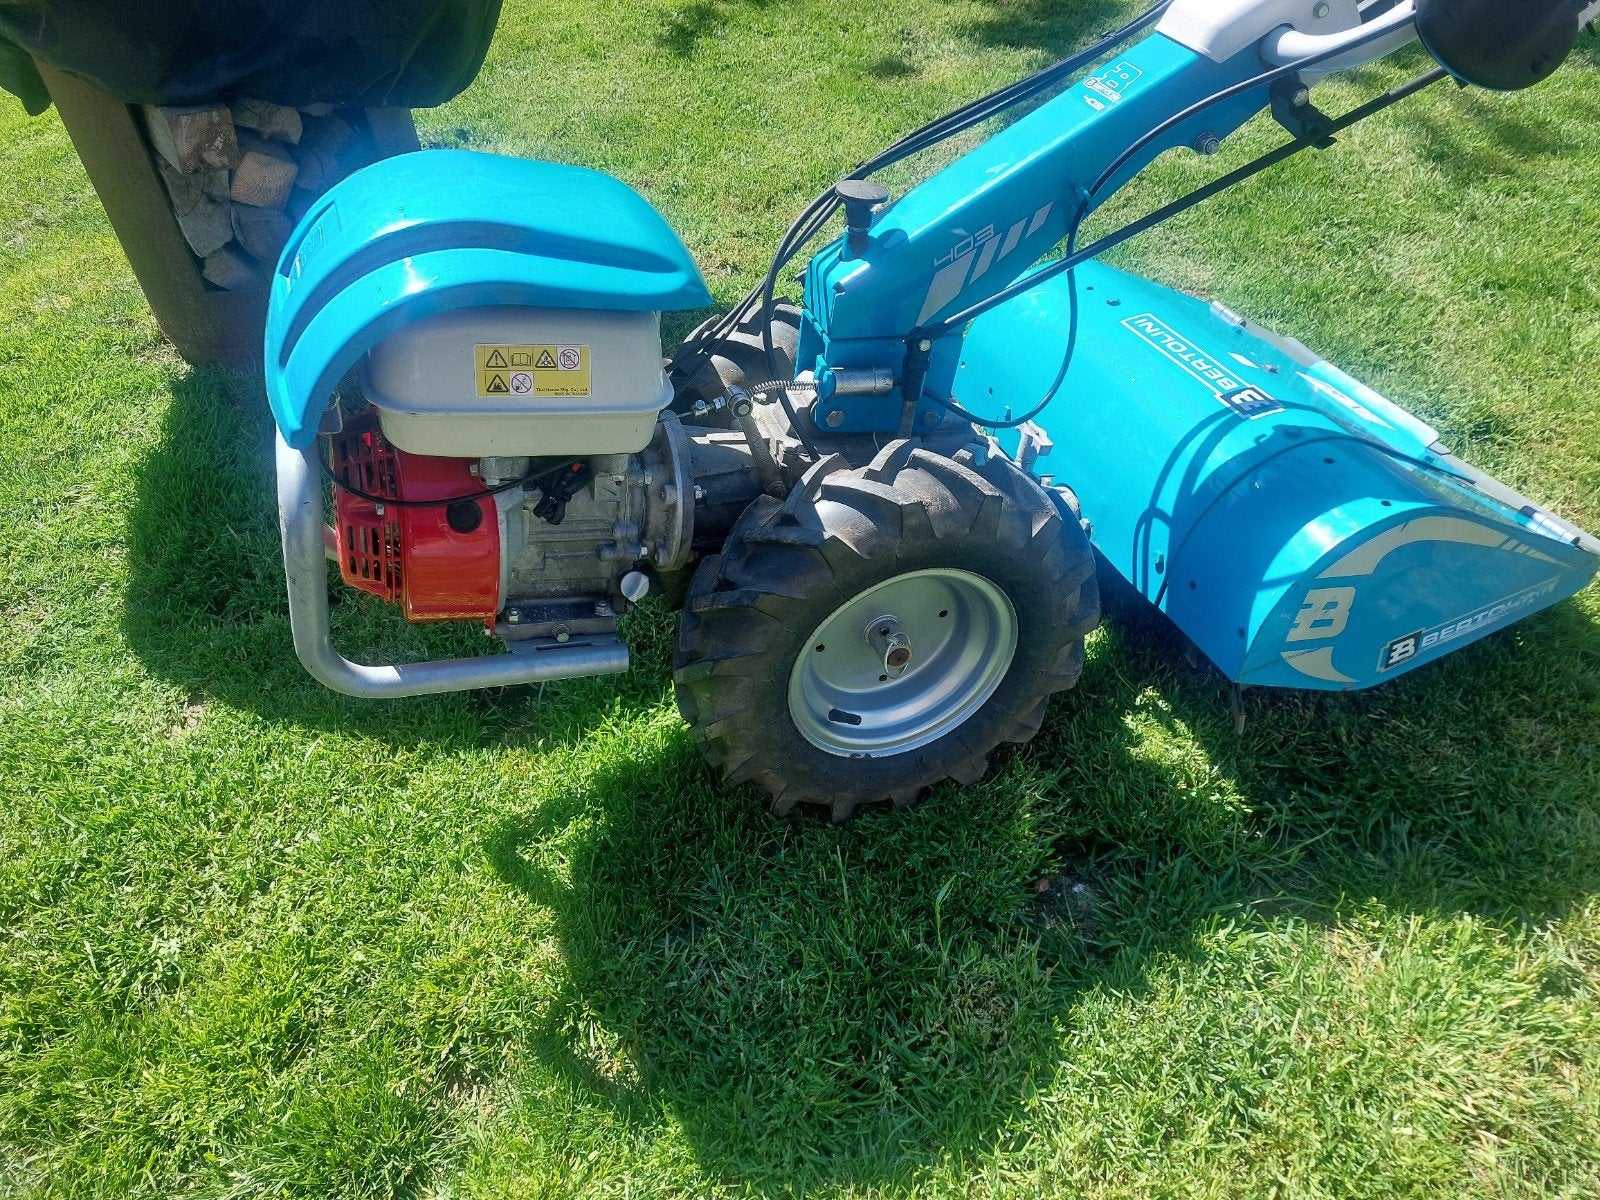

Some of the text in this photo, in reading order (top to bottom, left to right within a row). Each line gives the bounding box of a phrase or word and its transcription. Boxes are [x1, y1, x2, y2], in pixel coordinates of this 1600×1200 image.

[934, 223, 995, 267] 403
[1134, 318, 1241, 391] BERTOLINI
[1285, 586, 1356, 643] B
[1388, 638, 1416, 664] B
